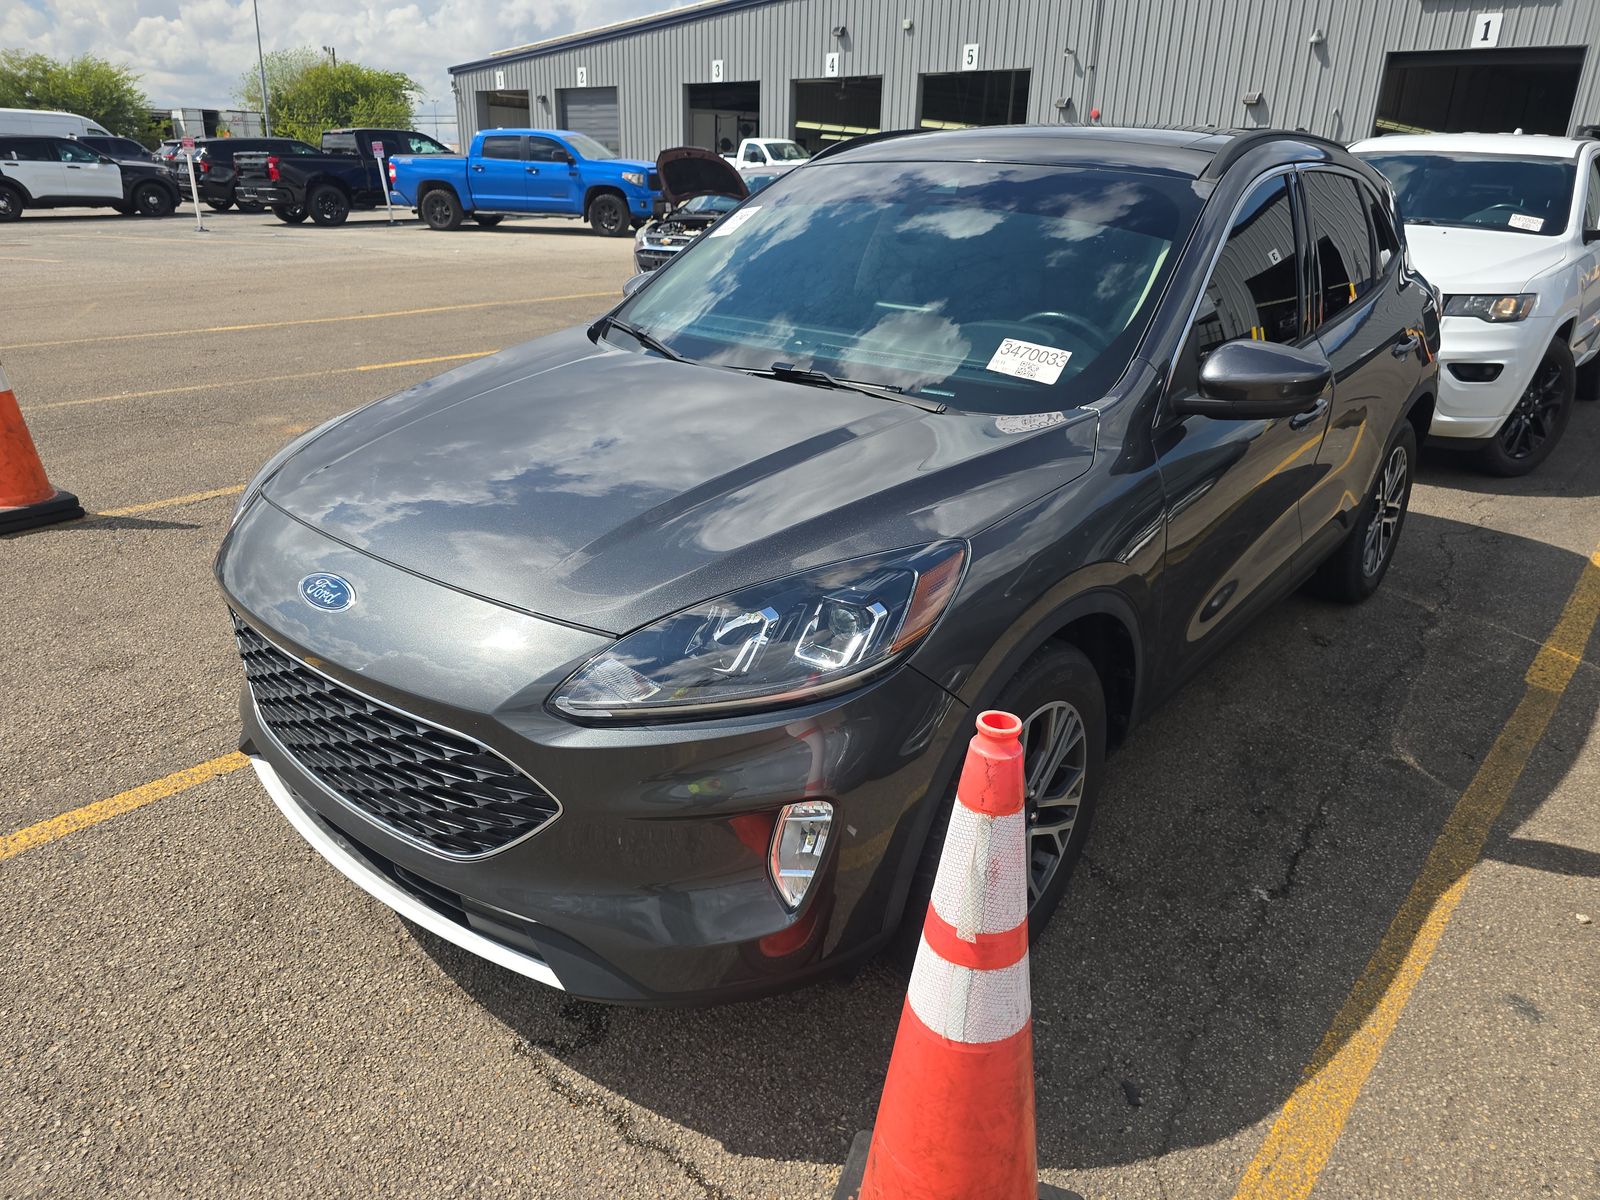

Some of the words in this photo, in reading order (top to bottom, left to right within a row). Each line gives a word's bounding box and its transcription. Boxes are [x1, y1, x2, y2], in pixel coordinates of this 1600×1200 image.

[1480, 19, 1491, 41] 1
[829, 57, 835, 72] 4
[967, 49, 974, 65] 5
[579, 71, 585, 84] 2
[714, 64, 720, 78] 3
[1000, 343, 1068, 368] 3470033
[306, 578, 342, 605] Ford
